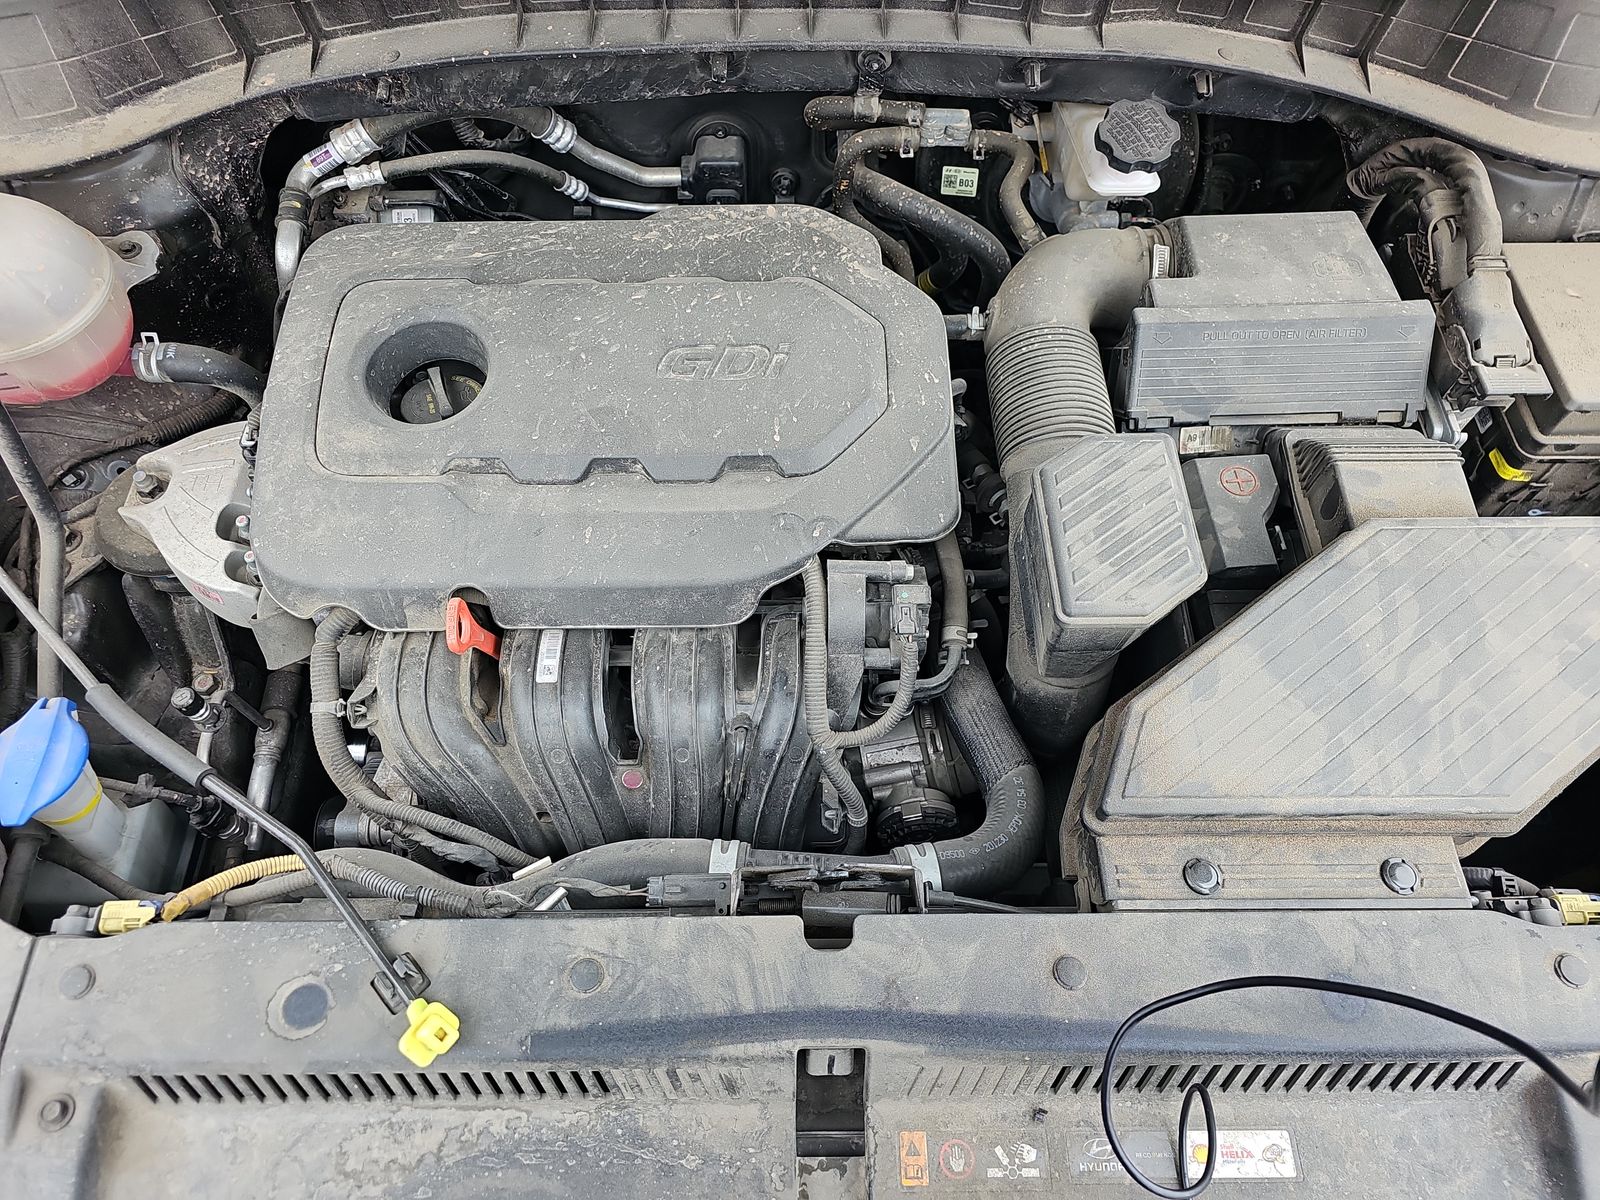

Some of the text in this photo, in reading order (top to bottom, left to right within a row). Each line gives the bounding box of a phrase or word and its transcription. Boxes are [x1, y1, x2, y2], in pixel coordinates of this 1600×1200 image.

[959, 178, 974, 188] B03
[1202, 327, 1368, 341] PULL OUT TO OPEN (AIR FILTER)
[656, 342, 792, 381] GDi
[1220, 1150, 1255, 1159] HELIX
[1080, 1161, 1126, 1172] HYUNDA
